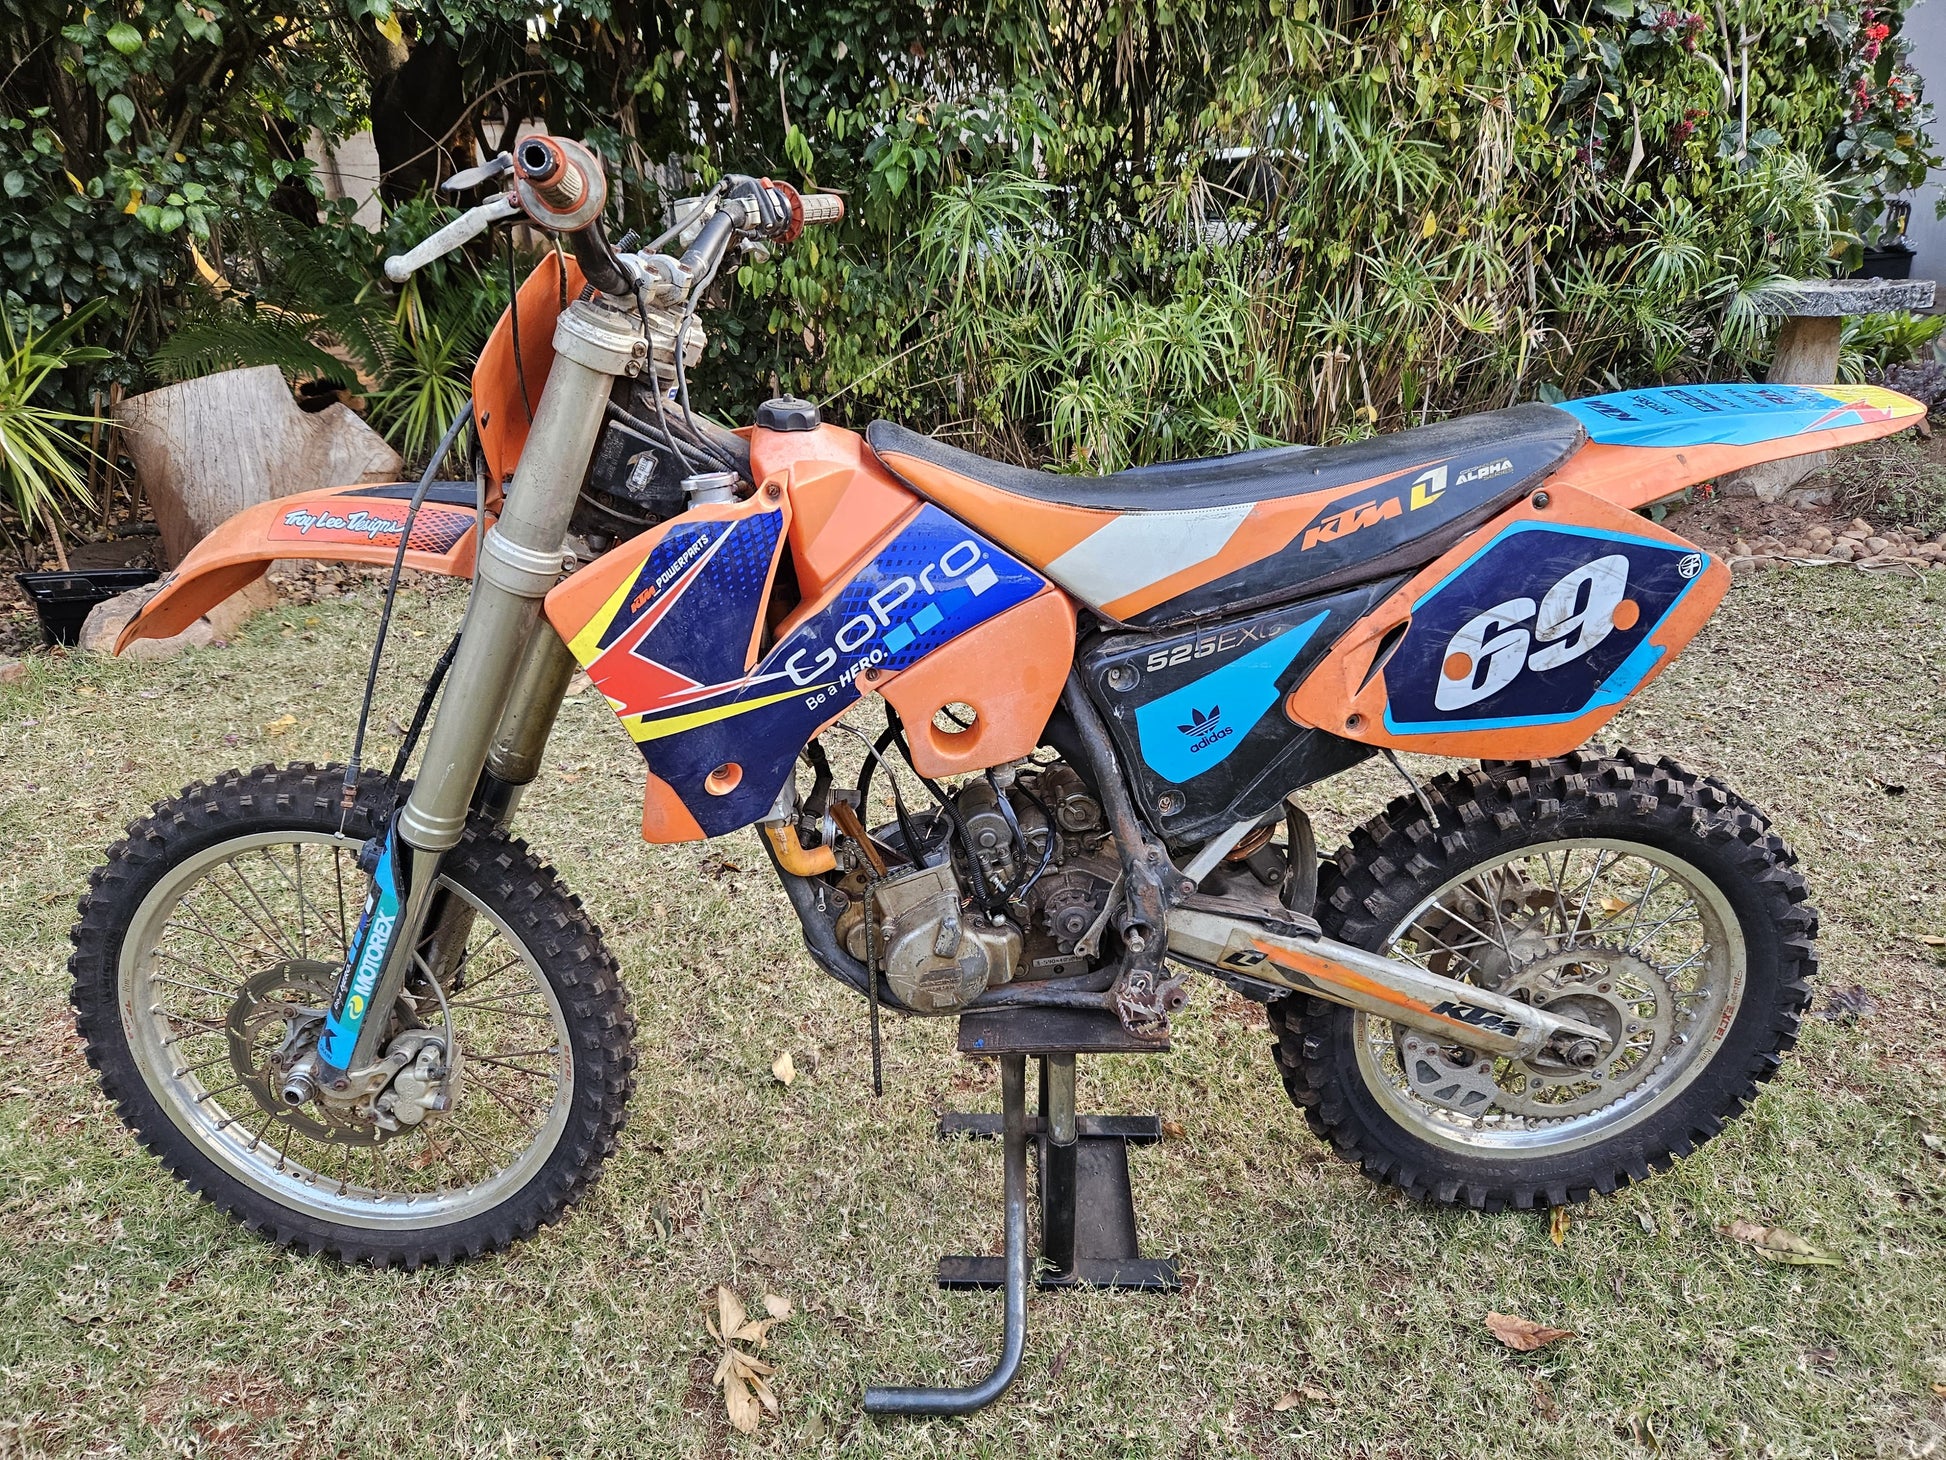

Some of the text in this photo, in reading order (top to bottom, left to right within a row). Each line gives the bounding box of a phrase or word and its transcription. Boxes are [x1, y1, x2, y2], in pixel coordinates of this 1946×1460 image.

[1456, 460, 1514, 486] ALPHA
[284, 509, 404, 540] Troy Lee Designs
[1301, 497, 1403, 551] KTM
[785, 540, 981, 686] GoPro
[1434, 554, 1630, 711] 69
[805, 692, 826, 711] Be
[827, 684, 838, 696] a
[1189, 726, 1233, 753] adidas
[354, 910, 396, 997] MOTOREX
[1431, 1001, 1521, 1036] KTM
[1713, 1005, 1735, 1042] EXCEL
